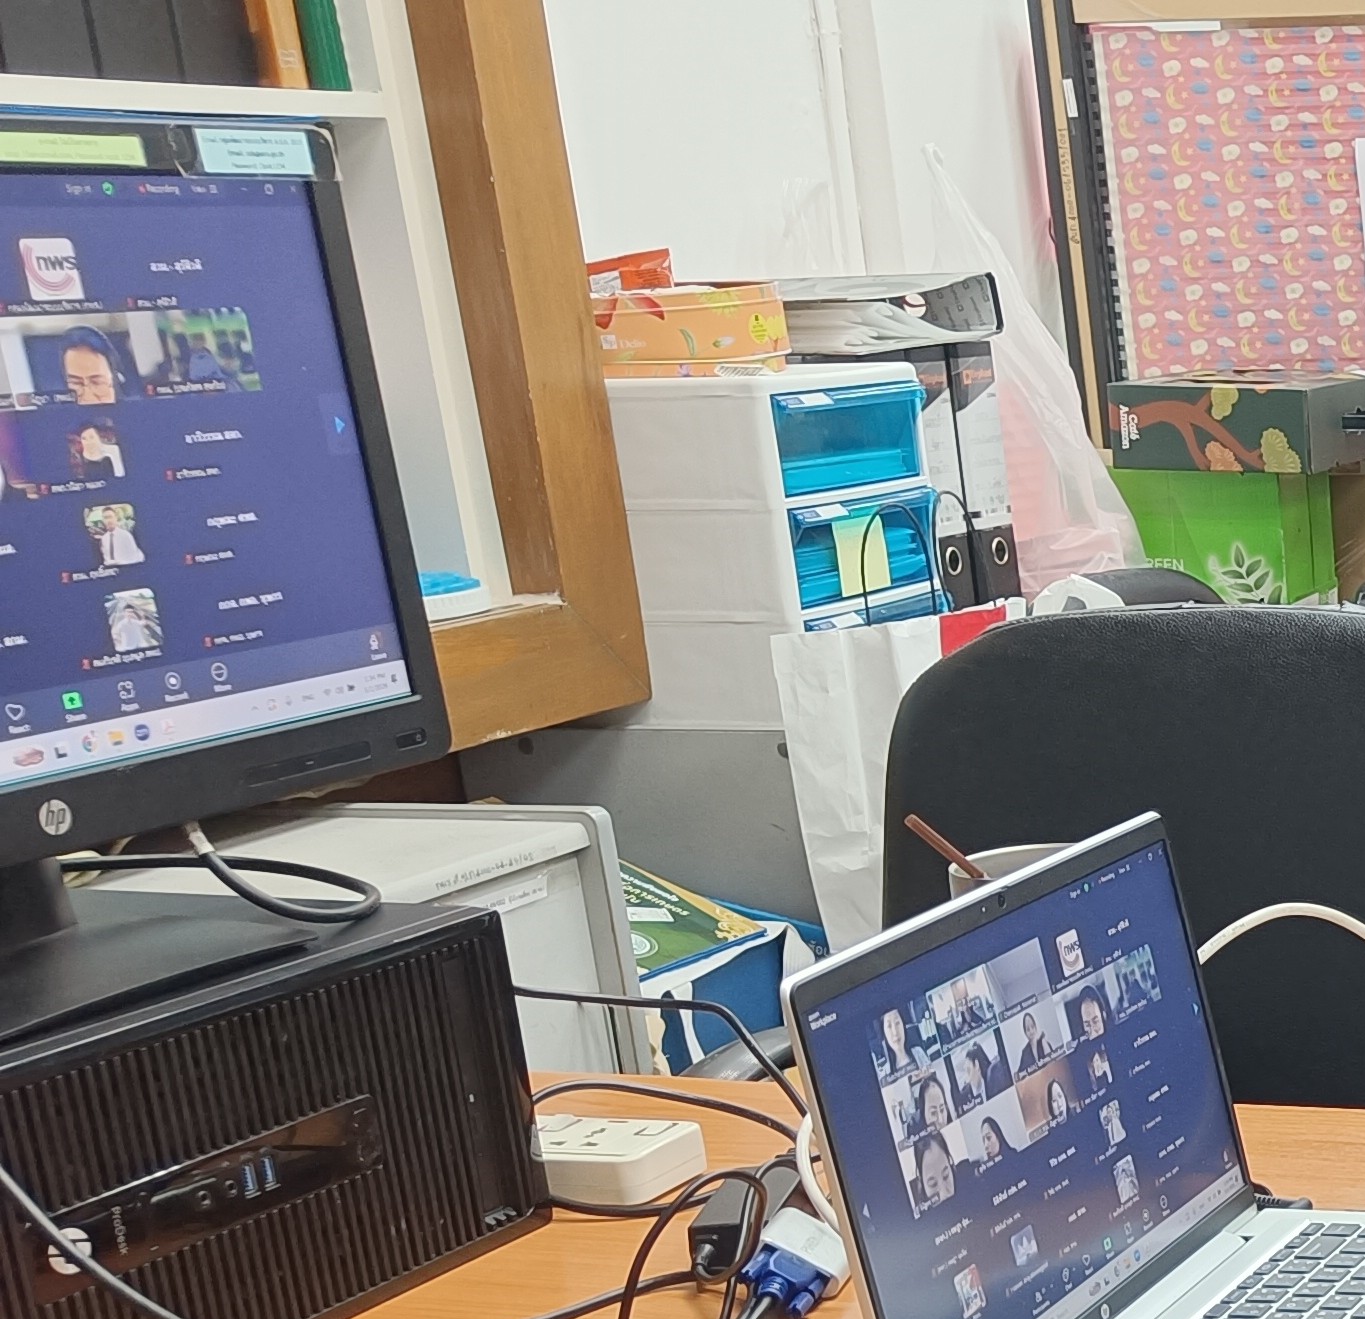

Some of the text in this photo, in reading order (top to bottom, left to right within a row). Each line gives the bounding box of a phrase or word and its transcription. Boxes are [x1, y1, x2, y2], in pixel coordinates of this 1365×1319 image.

[1119, 404, 1130, 450] Amazon
[45, 802, 66, 832] hp
[809, 1013, 837, 1030] Workplace
[111, 1206, 129, 1256] ProDesk
